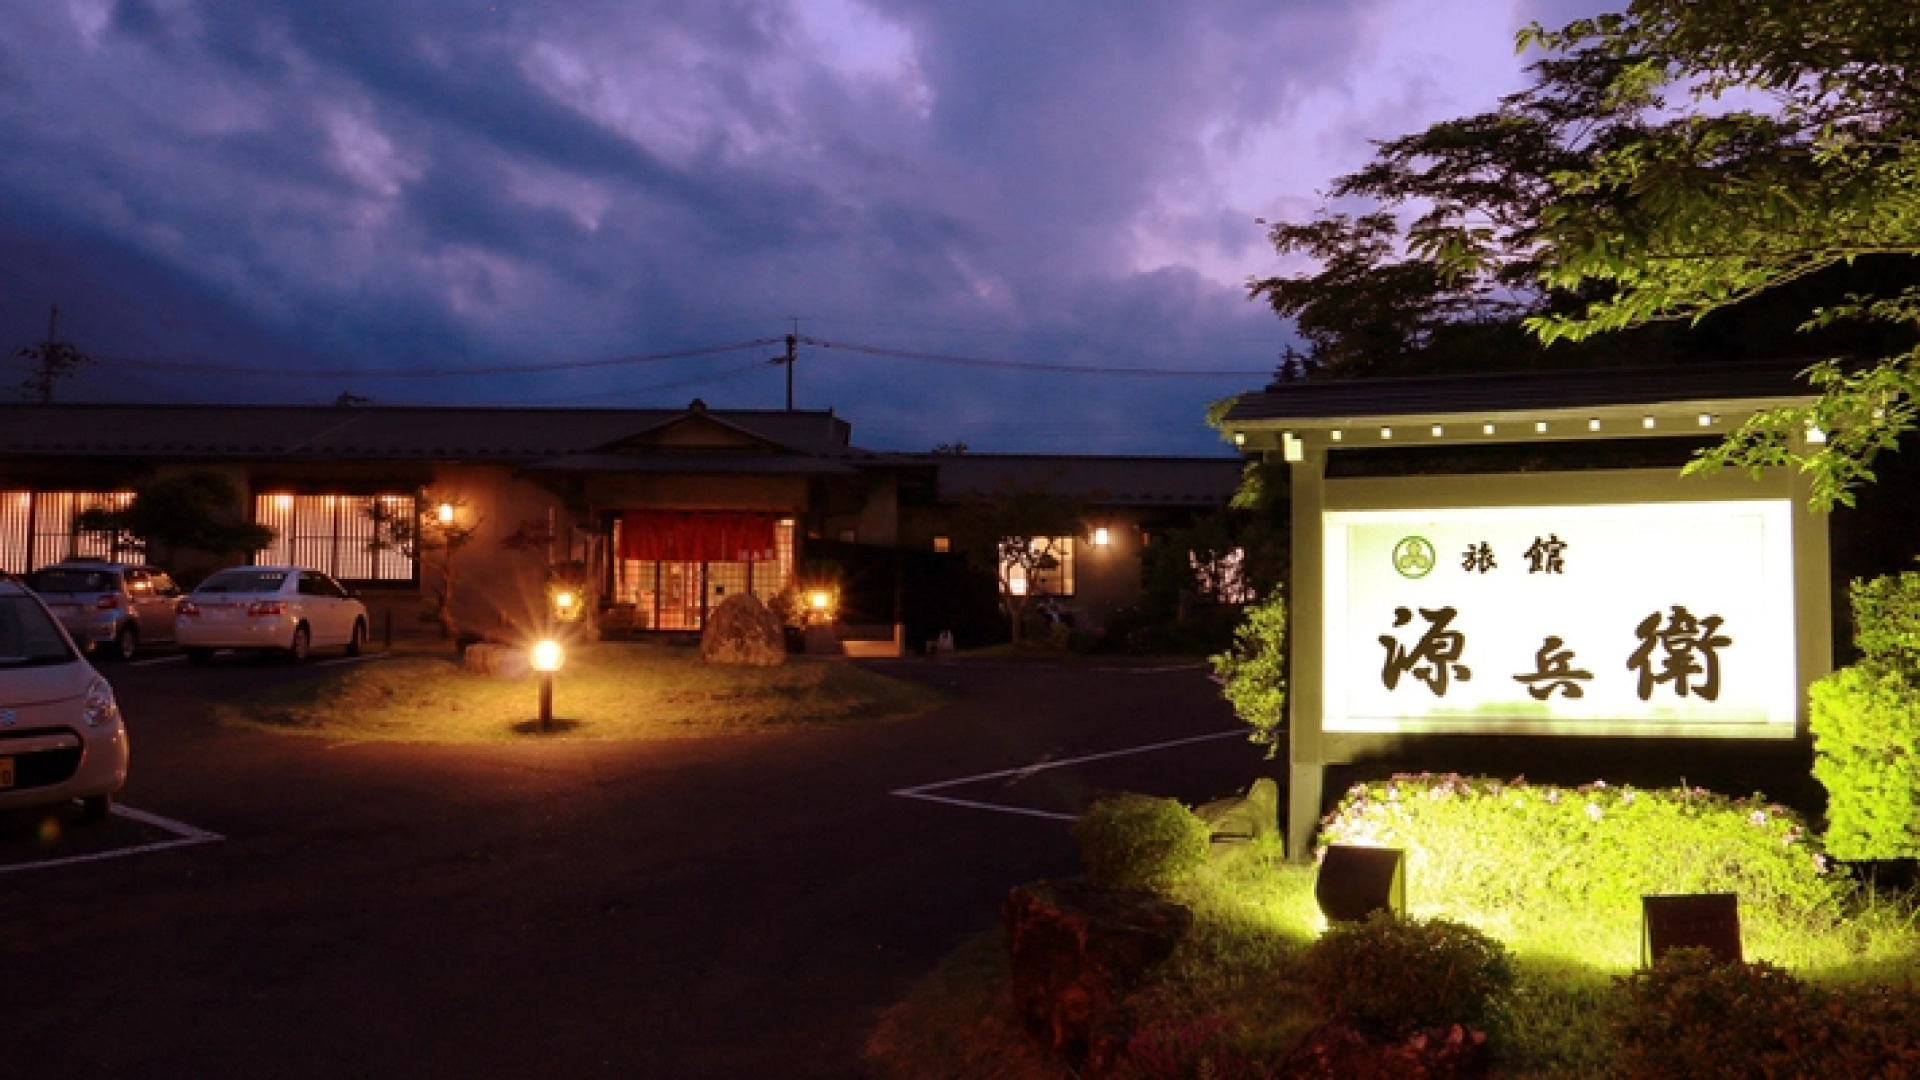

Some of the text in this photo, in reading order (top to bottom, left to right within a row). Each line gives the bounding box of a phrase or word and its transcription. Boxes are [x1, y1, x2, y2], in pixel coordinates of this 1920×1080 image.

[1461, 534, 1568, 575] 旅館
[1378, 604, 1732, 701] 源兵衛
